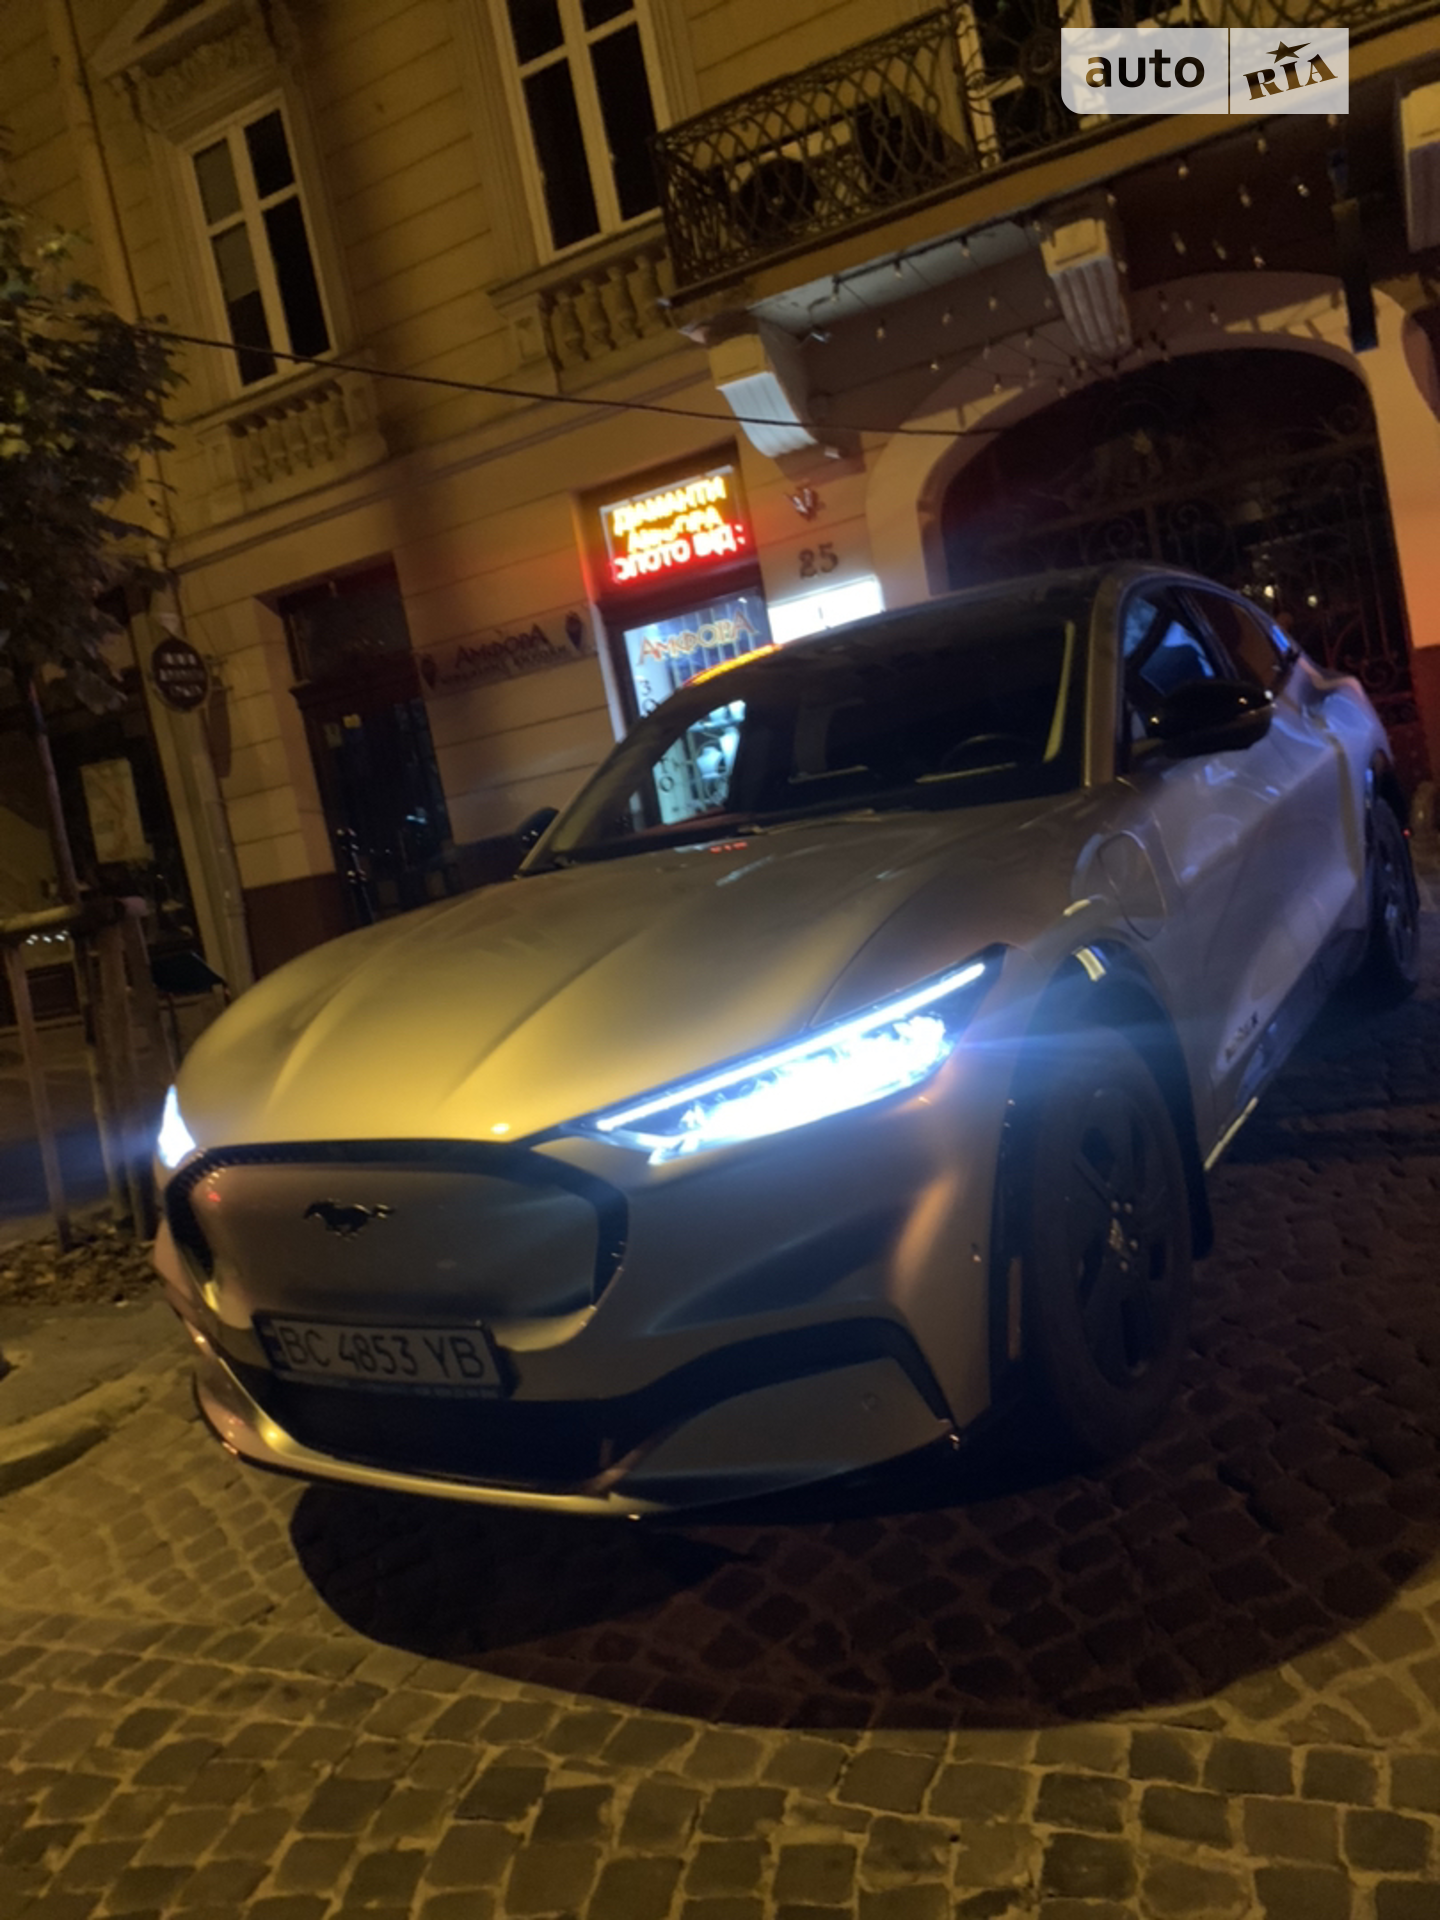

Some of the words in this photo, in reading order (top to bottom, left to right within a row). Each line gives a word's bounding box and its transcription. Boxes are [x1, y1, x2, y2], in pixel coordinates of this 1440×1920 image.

[799, 542, 839, 580] 25
[278, 1326, 331, 1367] BC
[337, 1333, 418, 1376] 4853
[422, 1335, 485, 1379] YB
